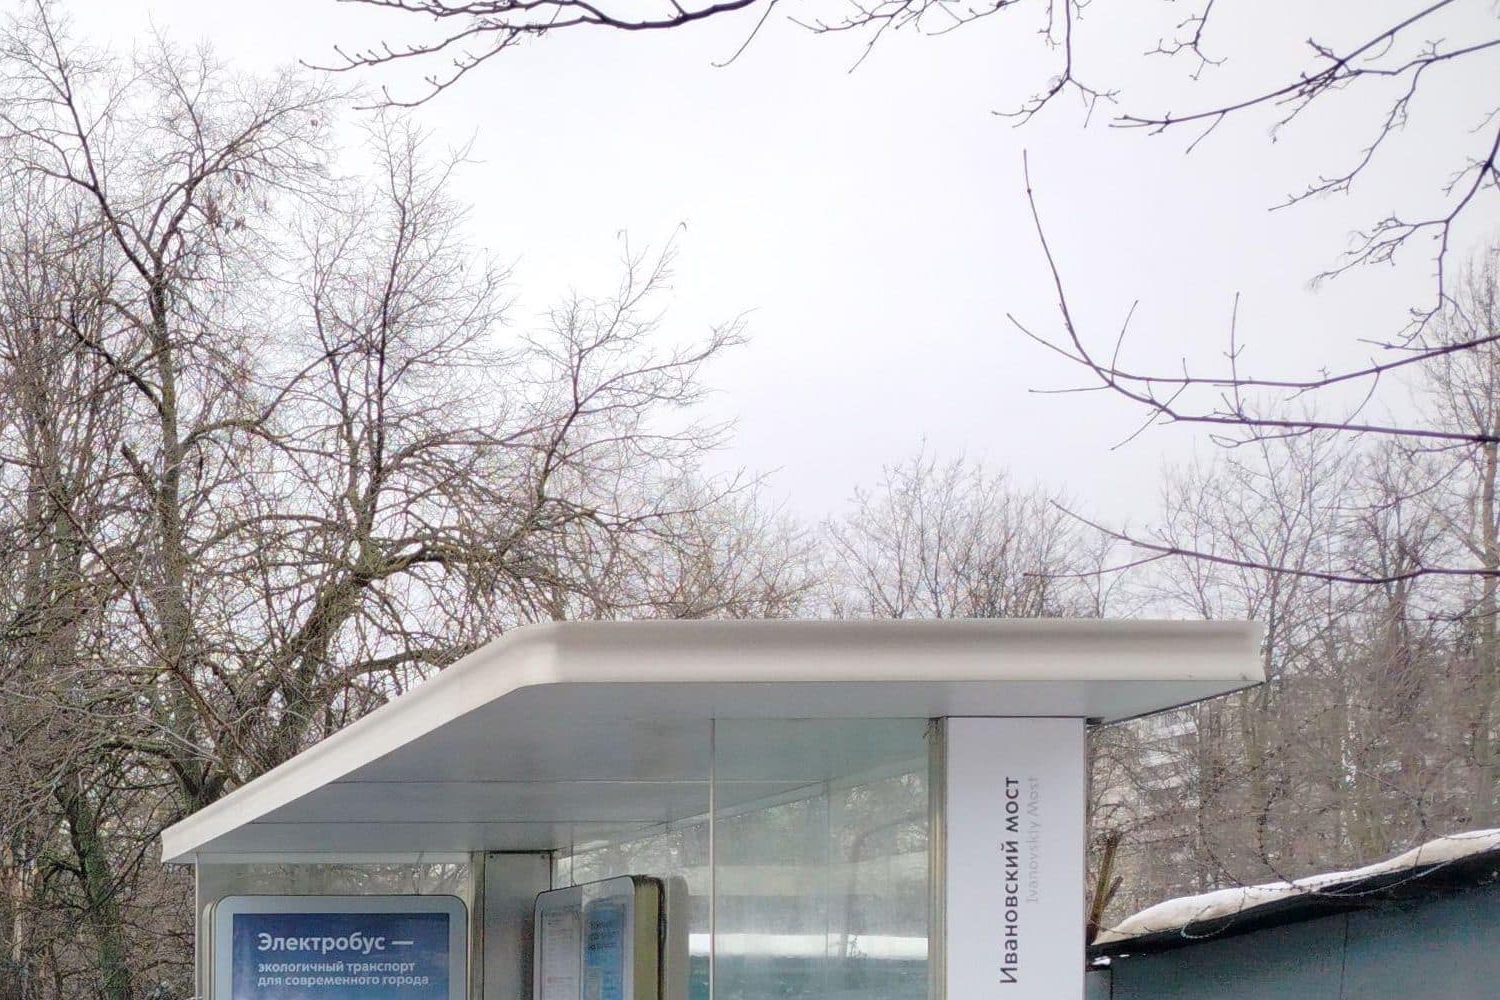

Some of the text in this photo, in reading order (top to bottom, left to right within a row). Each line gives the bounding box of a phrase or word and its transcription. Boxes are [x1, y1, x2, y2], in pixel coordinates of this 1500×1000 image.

[1026, 777, 1040, 816] Most
[1000, 776, 1020, 984] Ивановский мост
[257, 932, 386, 954] Электробус
[258, 961, 415, 974] экологичный транспорт
[257, 976, 429, 987] для современного города
